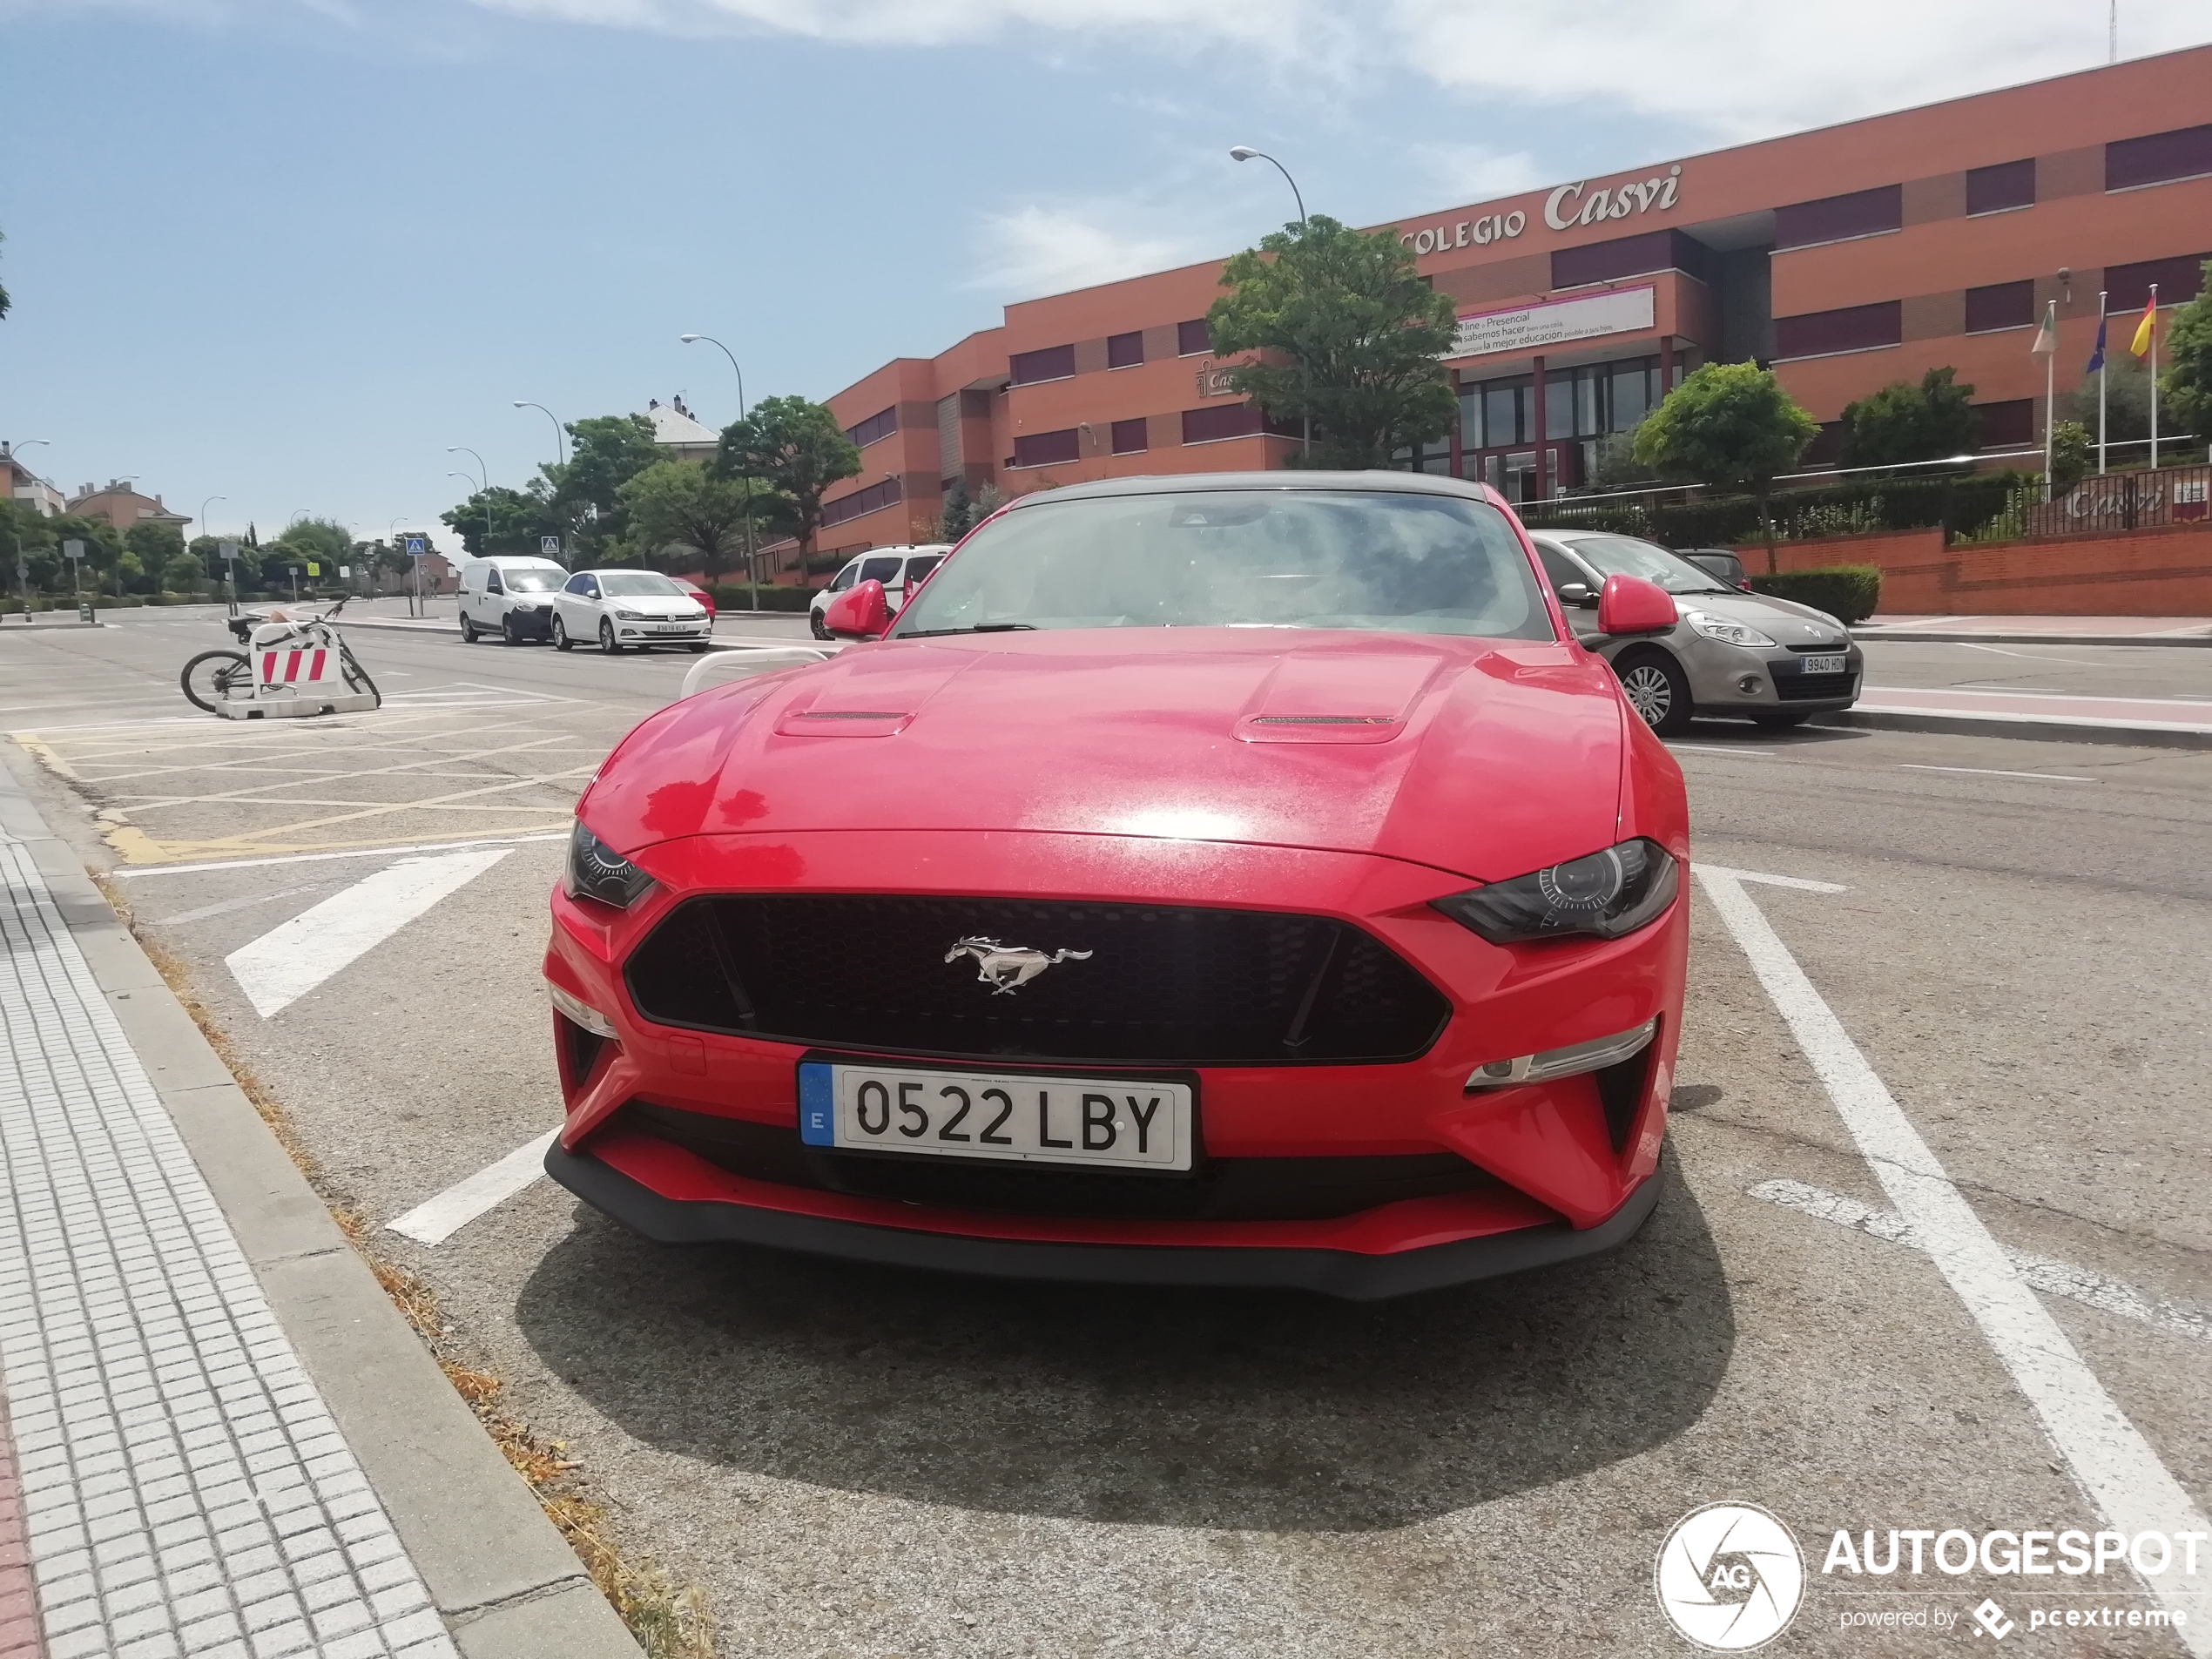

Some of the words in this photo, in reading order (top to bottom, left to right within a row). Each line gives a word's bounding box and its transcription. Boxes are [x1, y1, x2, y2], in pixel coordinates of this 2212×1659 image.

[1544, 165, 1683, 230] Casvi
[1465, 321, 1480, 331] line
[1487, 311, 1529, 327] Presencial
[1463, 331, 1501, 342] sabemos
[1501, 325, 1527, 336] hacer
[1483, 341, 1491, 350] la
[1493, 338, 1517, 349] mejor
[1519, 330, 1562, 345] educación
[1564, 328, 1584, 339] posible
[1210, 374, 1234, 388] Cas
[1808, 658, 1830, 671] 9940
[812, 1112, 824, 1129] E
[857, 1080, 1013, 1145] 0522
[1039, 1090, 1161, 1154] LBY
